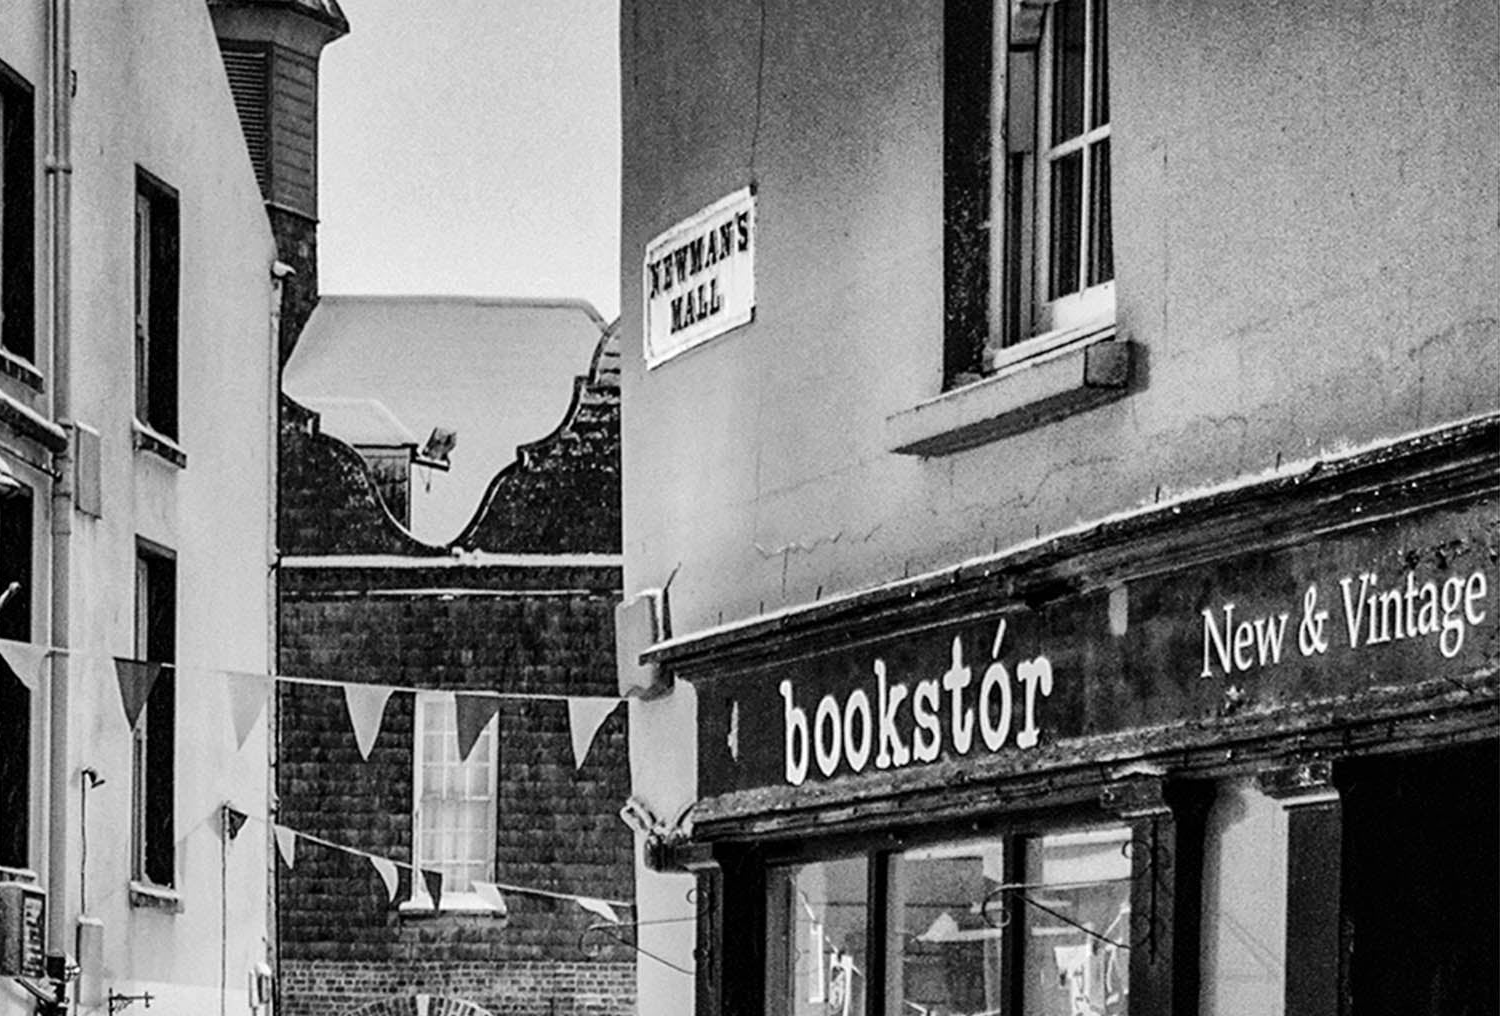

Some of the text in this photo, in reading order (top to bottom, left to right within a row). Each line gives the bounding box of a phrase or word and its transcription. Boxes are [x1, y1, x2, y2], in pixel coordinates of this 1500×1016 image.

[647, 210, 749, 300] NEWMAN'S
[670, 278, 723, 335] MALL
[1200, 568, 1488, 679] New & Vintage
[779, 618, 1053, 786] bookstór
